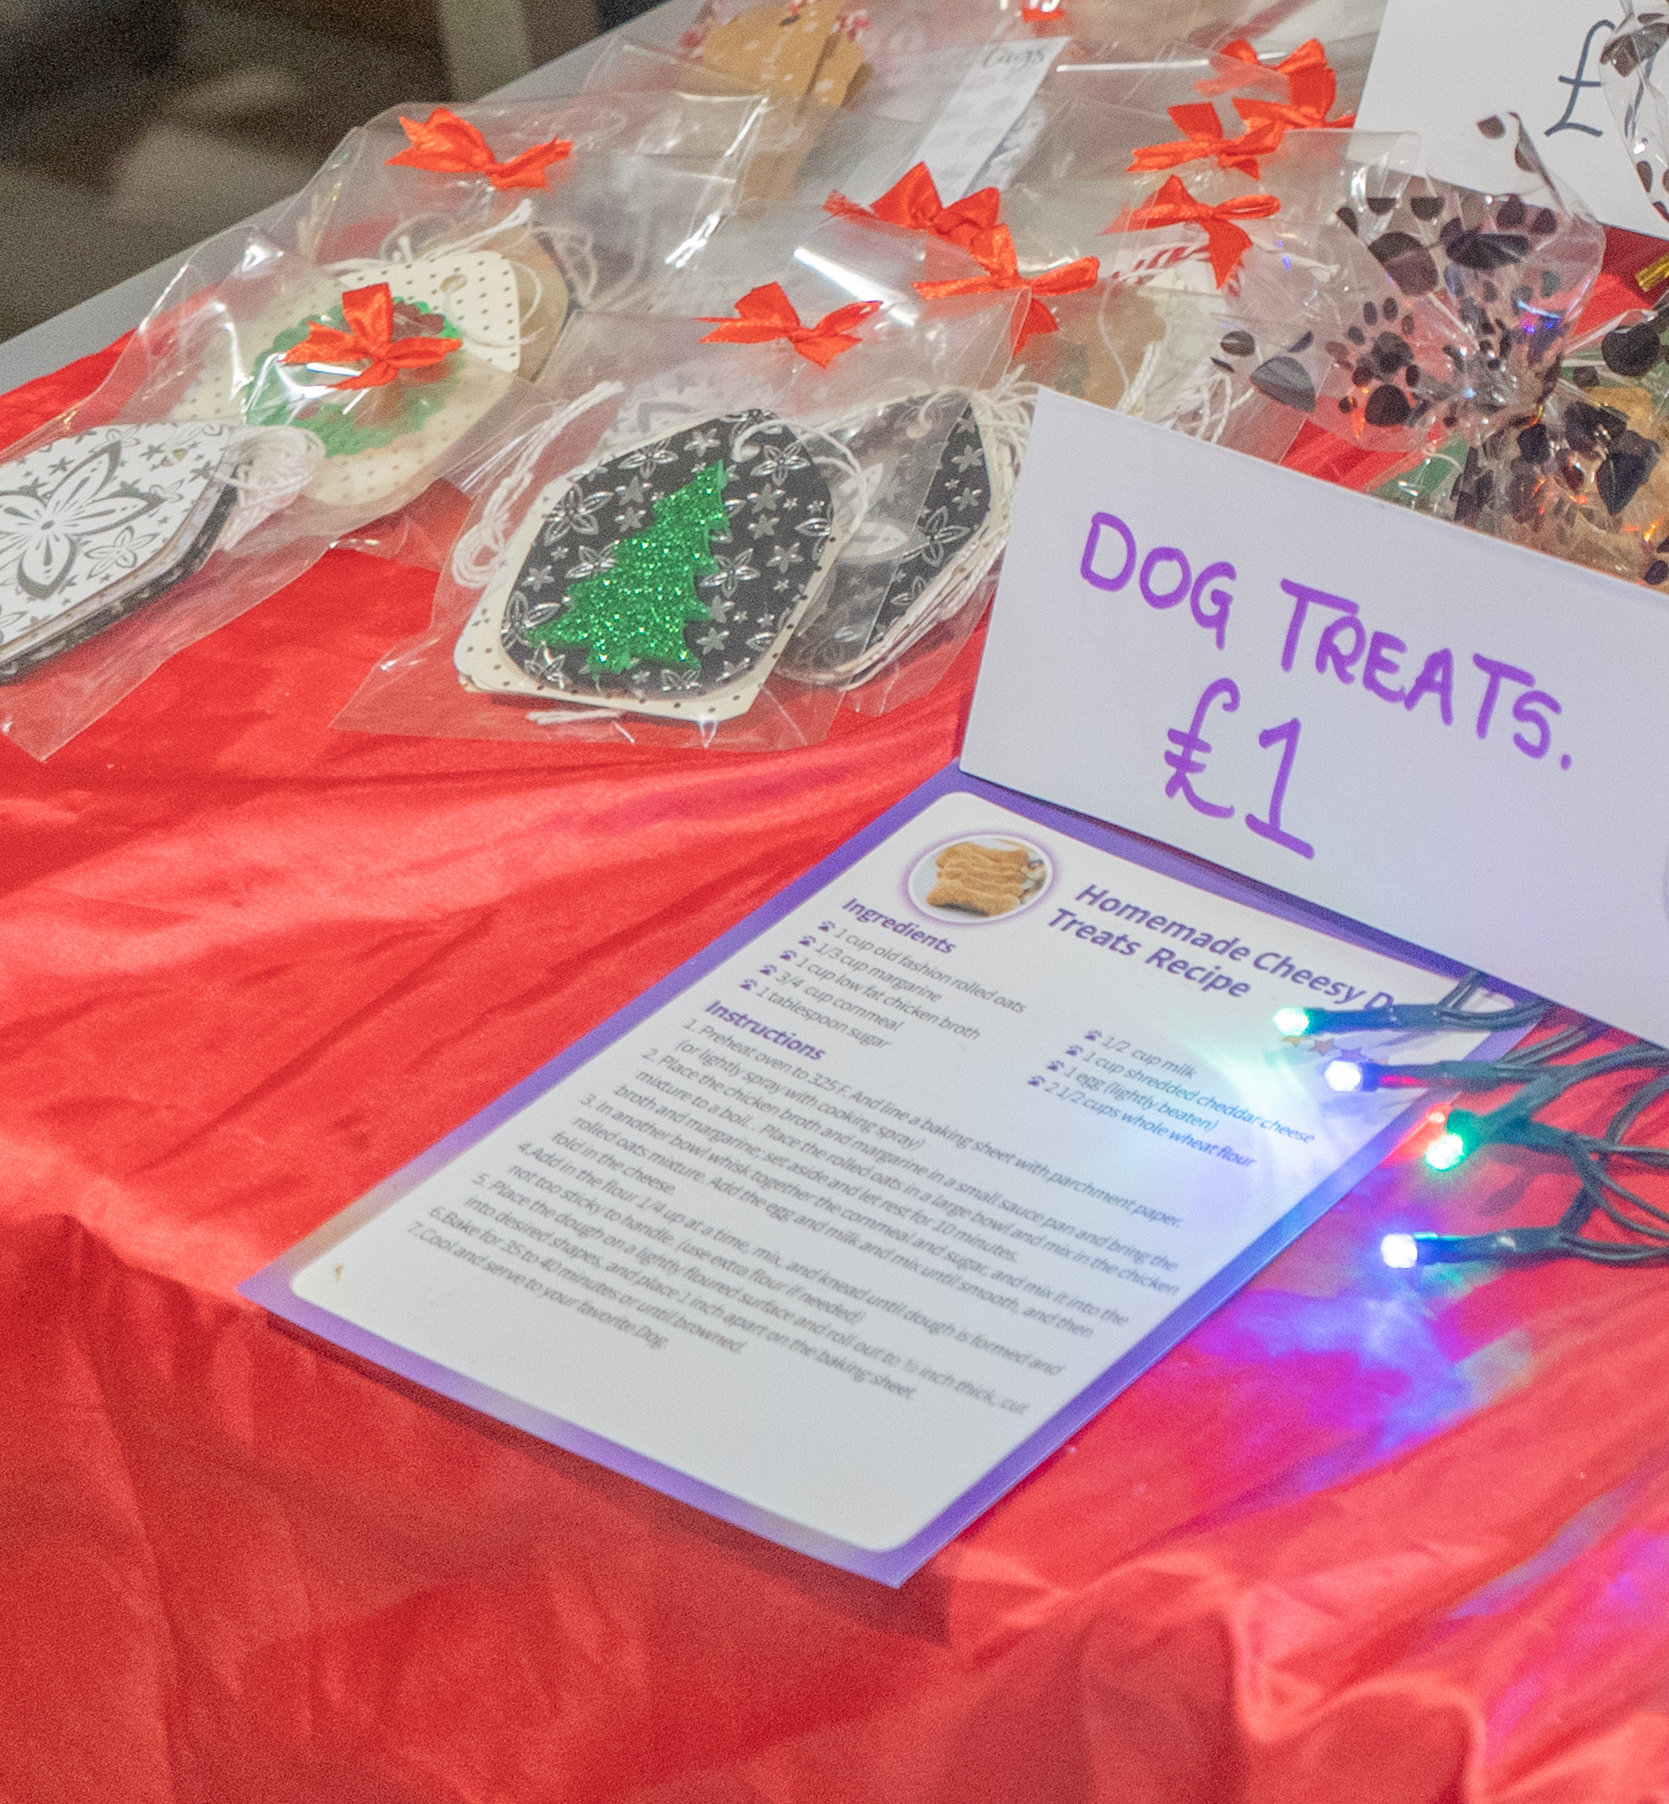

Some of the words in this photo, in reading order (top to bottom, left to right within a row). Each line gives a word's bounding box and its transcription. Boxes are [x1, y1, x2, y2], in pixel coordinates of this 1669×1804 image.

[1079, 510, 1239, 650] DOG
[1279, 577, 1573, 771] TREATS.
[1161, 677, 1316, 860] £1
[842, 898, 955, 953] Ingredients
[1048, 907, 1142, 955] Treats
[1144, 947, 1250, 997] Recipe
[1074, 884, 1250, 961] Homemade
[1252, 951, 1366, 1005] Cheesy
[775, 971, 804, 988] 3/4
[803, 986, 833, 1002] cup
[831, 998, 904, 1031] cornmeal
[806, 964, 836, 980] cup
[834, 973, 864, 991] low
[861, 985, 885, 1000] fat
[882, 996, 939, 1023] chicken
[937, 1016, 980, 1039] broth
[814, 942, 843, 959] 1/3
[839, 955, 869, 971] cup
[867, 967, 942, 1001] margarine
[845, 934, 874, 950] cup
[873, 946, 902, 961] old
[897, 955, 951, 983] fashion
[950, 979, 998, 1000] rolled
[992, 996, 1026, 1012] oats
[704, 1000, 825, 1059] Instructions
[767, 992, 848, 1032] tablespoon
[846, 1027, 891, 1048] sugar
[1101, 1036, 1131, 1052] 1/2
[1130, 1049, 1161, 1065] cup
[1160, 1060, 1196, 1078] milk
[697, 1048, 746, 1076] lightly
[742, 1071, 786, 1094] spray
[783, 1088, 818, 1106] with
[816, 1102, 878, 1133] cooking
[698, 1025, 757, 1057] Preheat
[753, 1052, 792, 1072] oven
[807, 1072, 840, 1091] 325
[848, 1091, 885, 1109] And
[879, 1101, 910, 1120] line
[919, 1118, 974, 1148] baking
[970, 1141, 1016, 1163] sheet
[1013, 1158, 1049, 1177] with
[1045, 1172, 1136, 1210] parchment
[1055, 1086, 1085, 1103] 1/2
[1081, 1098, 1121, 1117] cups
[1120, 1112, 1169, 1135] whole
[1168, 1131, 1219, 1154] wheat
[1216, 1145, 1255, 1166] flour
[1075, 1073, 1106, 1090] egg
[1103, 1081, 1159, 1110] (lightly
[1156, 1102, 1218, 1131] beaten)
[1094, 1057, 1125, 1073] cup
[1123, 1069, 1199, 1100] shredded
[1196, 1096, 1261, 1123] cheddar
[1259, 1120, 1314, 1143] cheese
[551, 1131, 586, 1151] fold
[596, 1153, 624, 1170] the
[613, 1084, 656, 1109] broth
[654, 1105, 690, 1123] and
[761, 1152, 790, 1167] set
[785, 1162, 829, 1183] aside
[826, 1178, 862, 1196] and
[857, 1188, 882, 1205] let
[878, 1200, 913, 1218] rest
[909, 1209, 934, 1225] for
[634, 1071, 693, 1100] mixture
[758, 1123, 801, 1147] Place
[799, 1142, 827, 1158] the
[824, 1153, 874, 1176] rolled
[869, 1172, 905, 1190] oats
[930, 1194, 972, 1217] large
[969, 1210, 1014, 1234] bowl
[1008, 1228, 1046, 1246] and
[1041, 1240, 1075, 1258] mix
[1089, 1257, 1118, 1274] the
[1116, 1268, 1179, 1295] chicken
[657, 1054, 699, 1079] Place
[697, 1074, 724, 1090] the
[722, 1087, 780, 1115] chicken
[777, 1108, 821, 1132] broth
[819, 1127, 855, 1144] and
[850, 1140, 928, 1175] margarine
[954, 1182, 1002, 1205] small
[997, 1199, 1044, 1222] sauce
[1039, 1217, 1075, 1234] pan
[1073, 1230, 1112, 1247] and
[1105, 1238, 1152, 1264] bring
[1149, 1255, 1178, 1271] the
[610, 1110, 673, 1140] another
[668, 1134, 711, 1157] bowl
[706, 1152, 751, 1176] whisk
[749, 1170, 817, 1201] together
[813, 1196, 842, 1213] the
[839, 1208, 916, 1243] cornmeal
[909, 1238, 948, 1255] and
[989, 1270, 1027, 1287] and
[1022, 1282, 1055, 1299] mix
[1065, 1296, 1101, 1315] into
[1099, 1308, 1128, 1325] the
